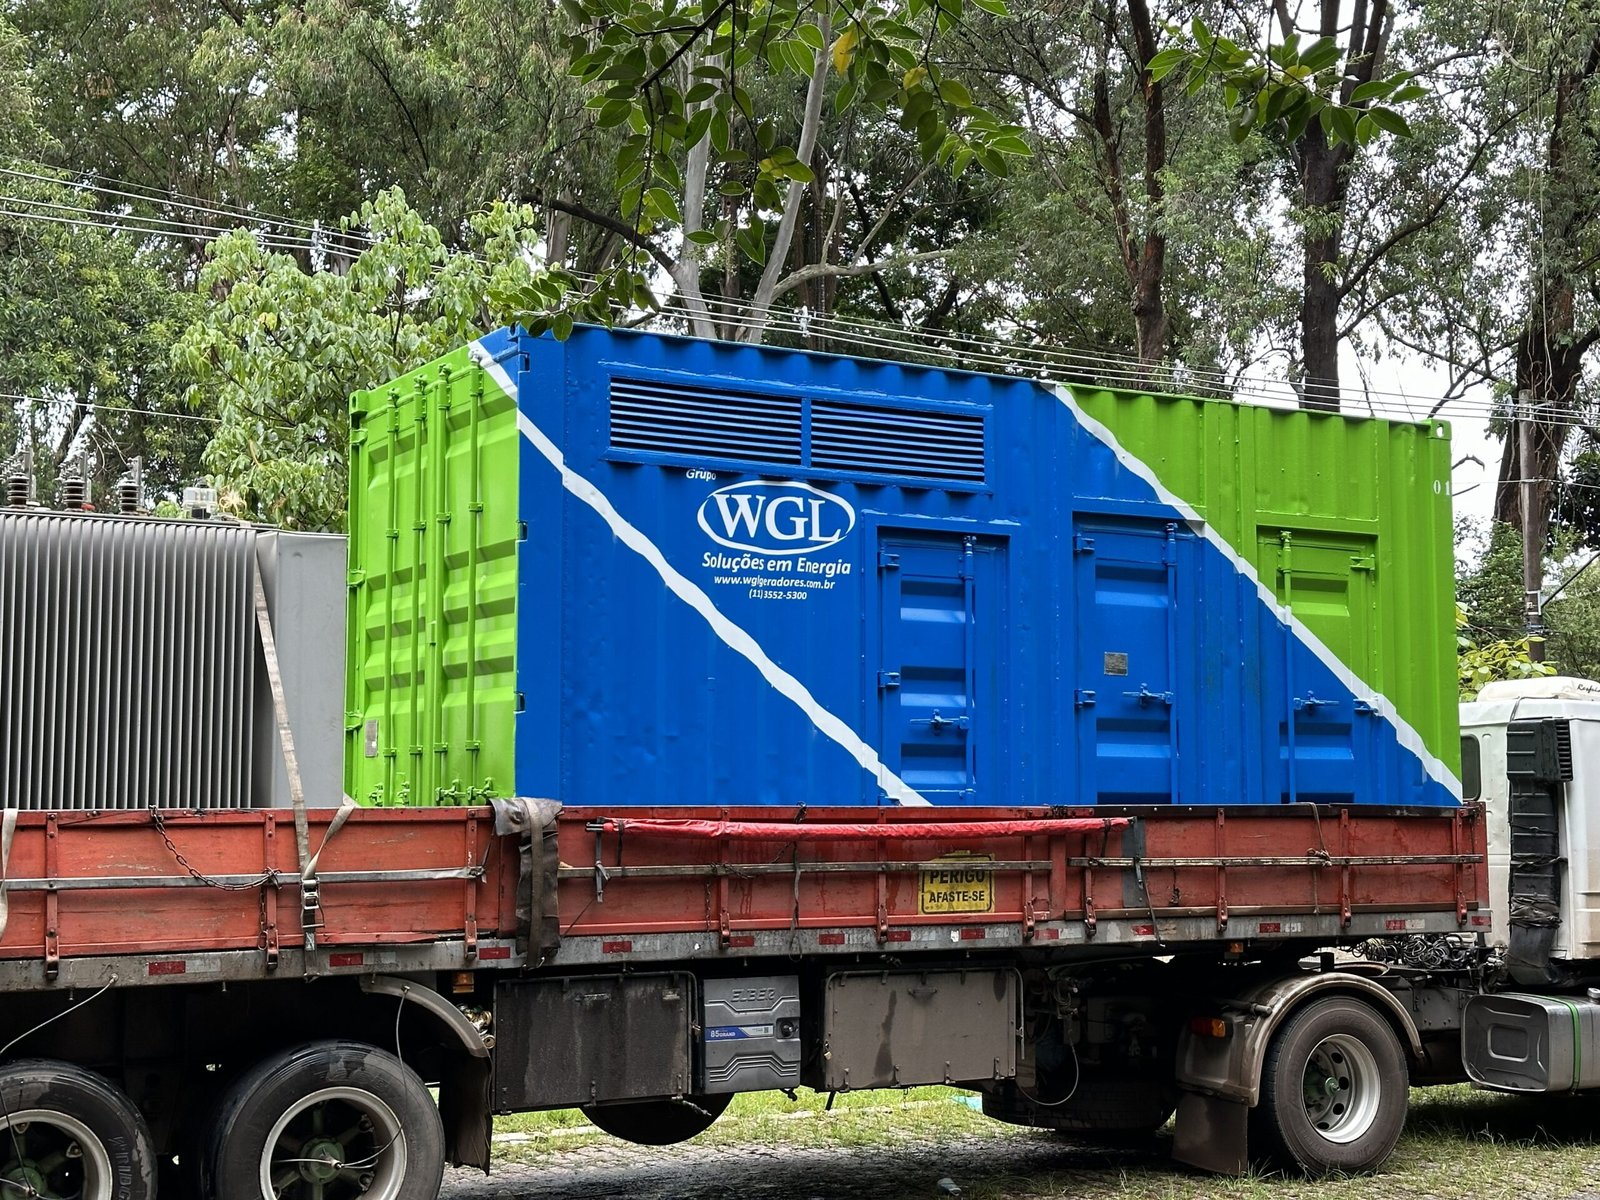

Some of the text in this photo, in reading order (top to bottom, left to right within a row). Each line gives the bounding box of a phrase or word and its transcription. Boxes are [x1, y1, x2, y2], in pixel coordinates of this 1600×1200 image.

[686, 468, 717, 482] Grupo
[712, 493, 841, 542] WGL
[702, 551, 851, 578] Soluções em Energia
[714, 574, 835, 590] www.wglgeradores.com.br
[749, 588, 807, 600] (11)3552-5300
[929, 870, 985, 884] PERIGO
[929, 890, 985, 903] AFASTE-SE
